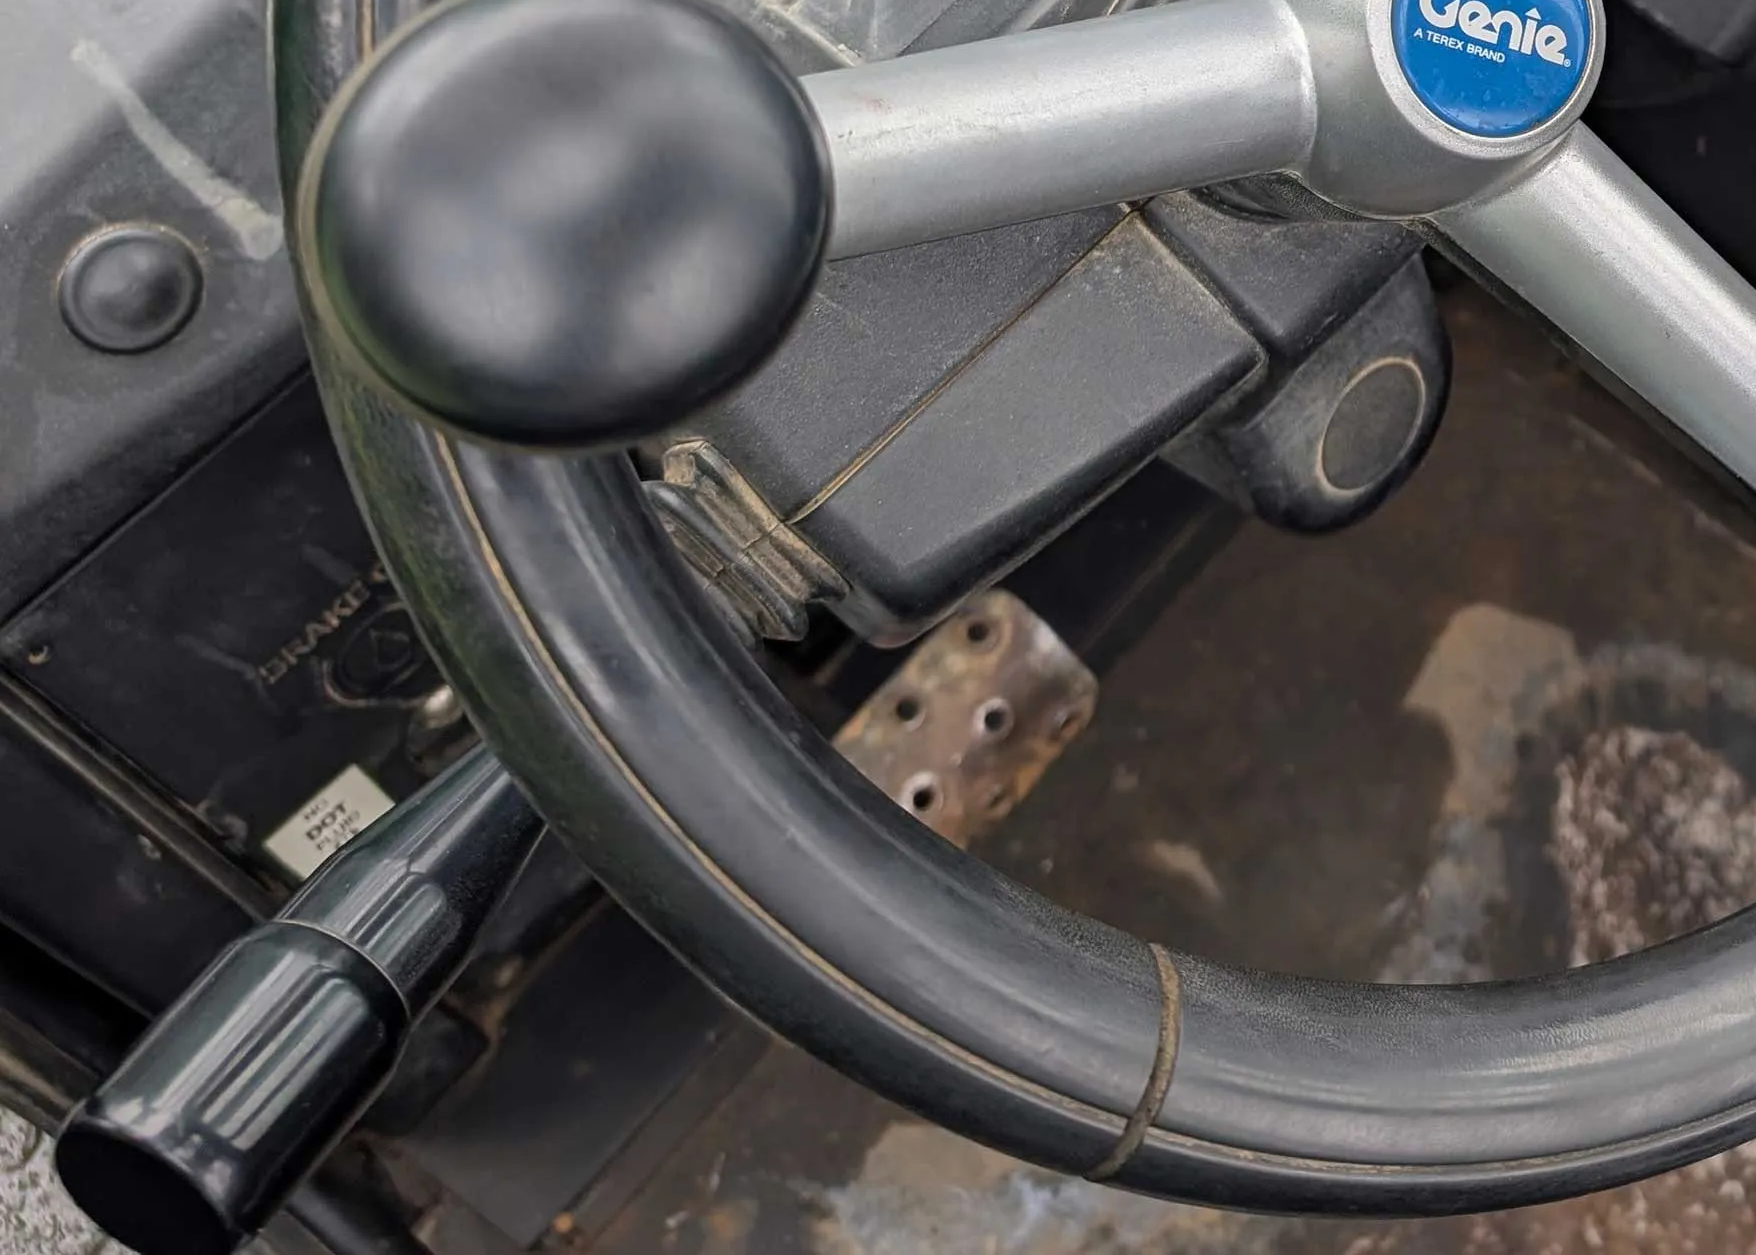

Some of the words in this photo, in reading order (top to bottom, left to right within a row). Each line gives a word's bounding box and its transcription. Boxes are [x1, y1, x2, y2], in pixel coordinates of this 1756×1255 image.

[1413, 28, 1424, 39] A
[1426, 30, 1464, 51] TEREX
[1467, 43, 1506, 63] BRAND
[305, 800, 346, 841] DOT
